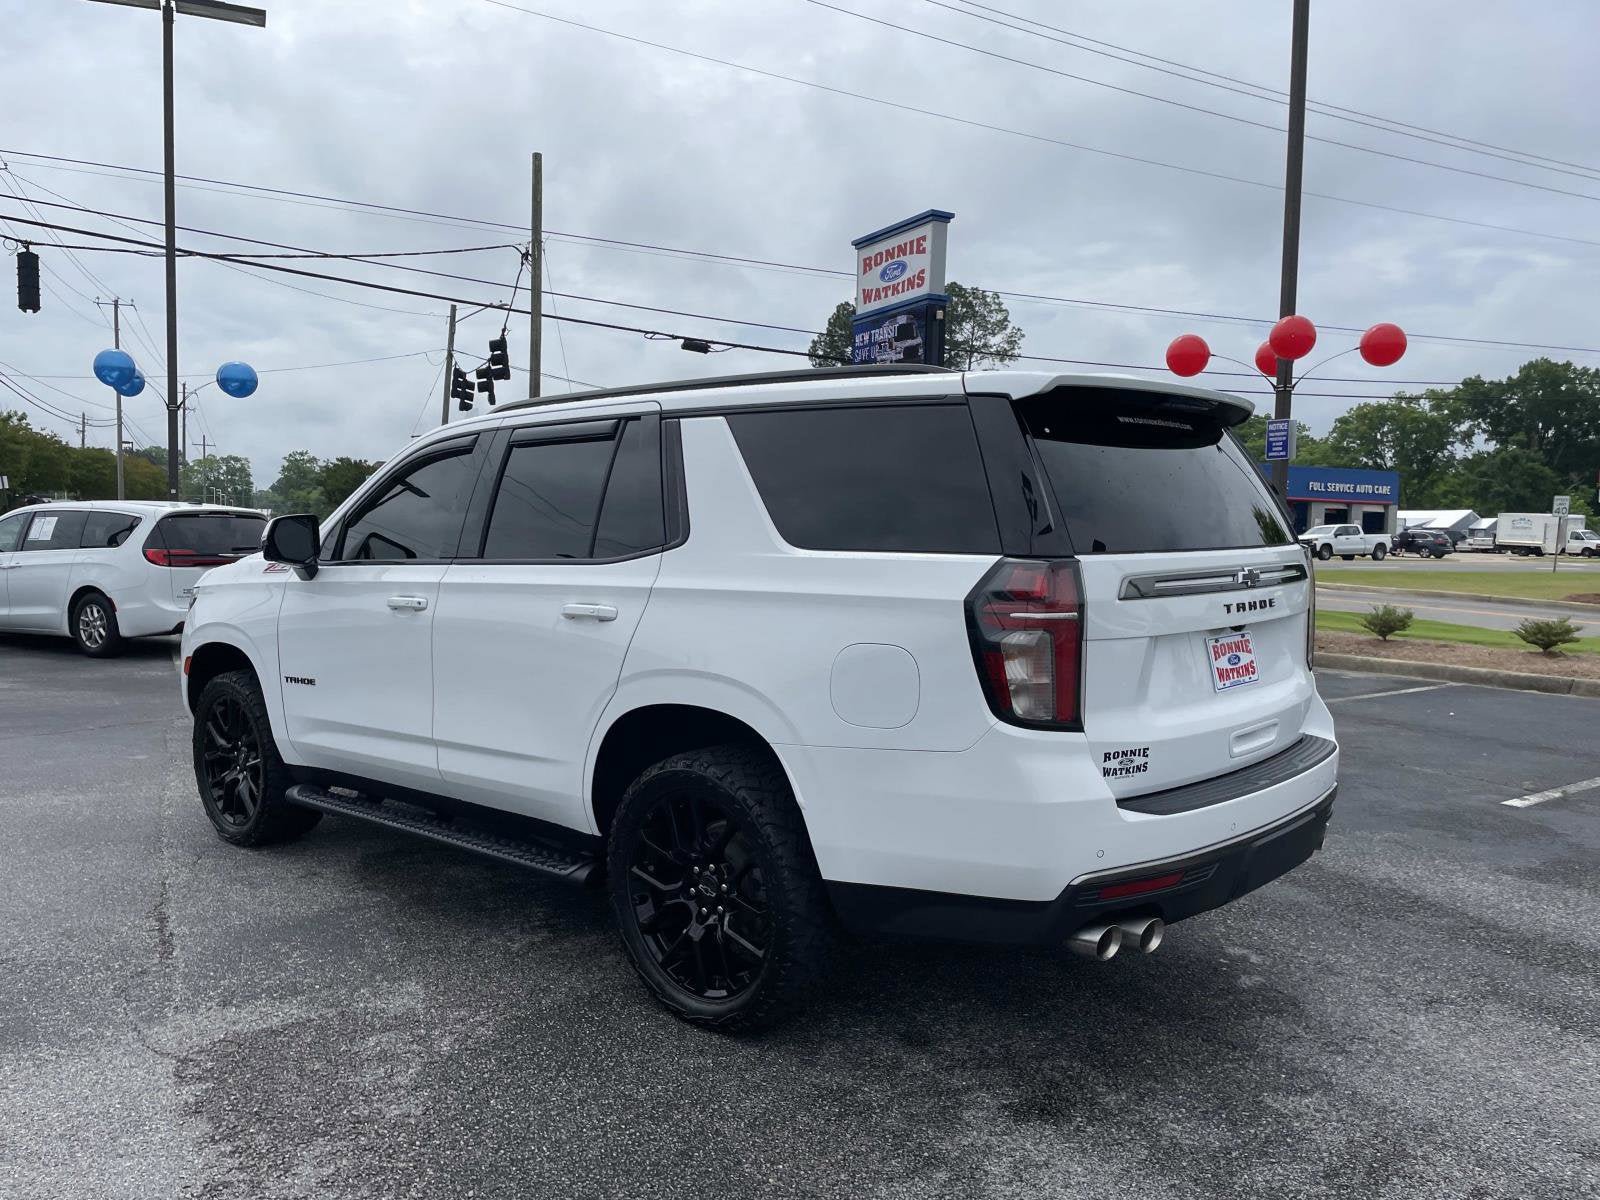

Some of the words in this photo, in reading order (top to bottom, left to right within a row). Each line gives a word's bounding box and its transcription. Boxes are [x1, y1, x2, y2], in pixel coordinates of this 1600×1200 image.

[863, 235, 926, 275] RONNIE
[862, 268, 925, 305] WATKINS
[855, 331, 870, 347] NEW
[871, 324, 898, 342] TRANSIT
[1268, 422, 1288, 430] NOTICE
[1309, 481, 1325, 491] FULL
[1327, 482, 1354, 493] SERVICE
[1356, 484, 1373, 494] AUTO
[1374, 485, 1391, 495] CARE
[1554, 506, 1568, 515] 40
[1223, 598, 1276, 614] TAHOE
[1212, 639, 1252, 661] RONNIE
[1216, 660, 1256, 683] WATKINS
[284, 676, 316, 686] TAHOE
[1103, 747, 1149, 763] RONNIE
[1102, 762, 1148, 778] WATKINS
